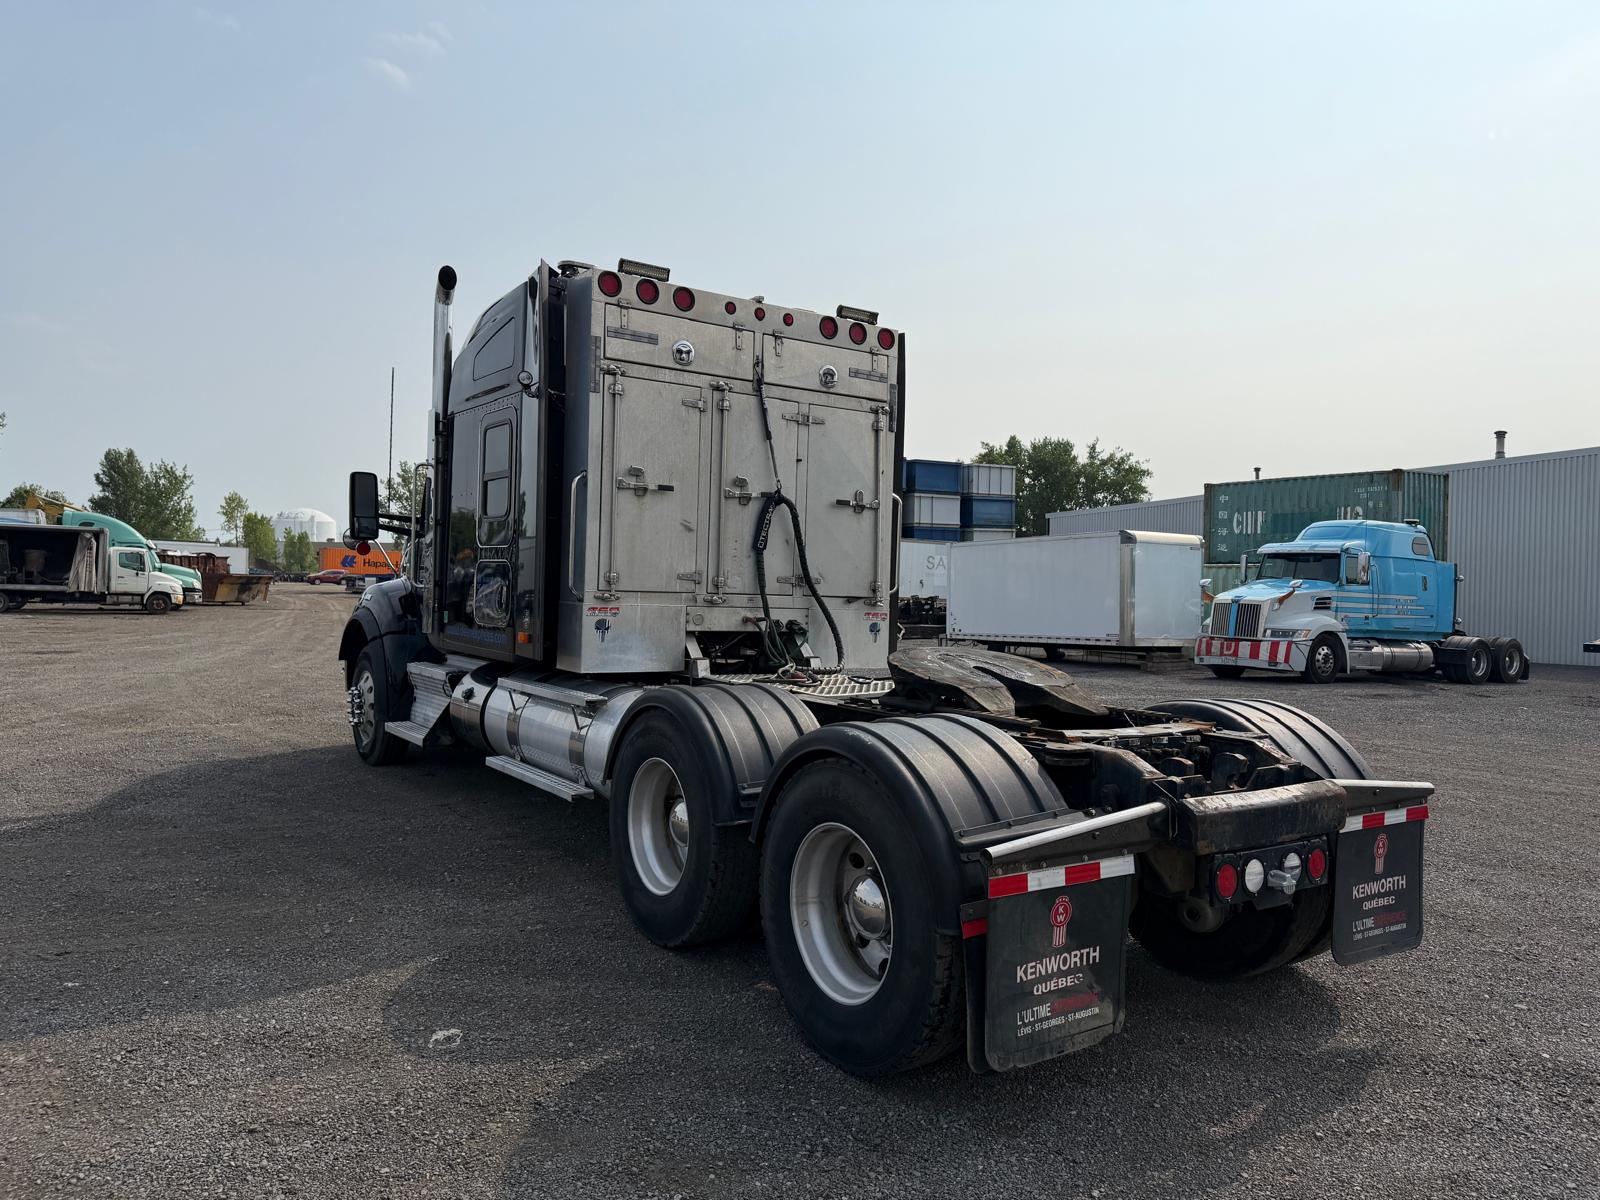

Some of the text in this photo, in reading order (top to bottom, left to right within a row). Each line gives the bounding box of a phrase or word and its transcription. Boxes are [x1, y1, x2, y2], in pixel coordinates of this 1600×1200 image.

[1352, 875, 1406, 899] KENWORTH
[1362, 896, 1395, 910] QUÉBEC
[1016, 946, 1099, 983] KENWORTH
[1033, 973, 1083, 995] QUÉBEC
[1017, 1002, 1051, 1025] L'ULTIME
[1034, 1015, 1066, 1032] ST-GEORGES
[1067, 1006, 1100, 1022] ST-AUGUSTIN
